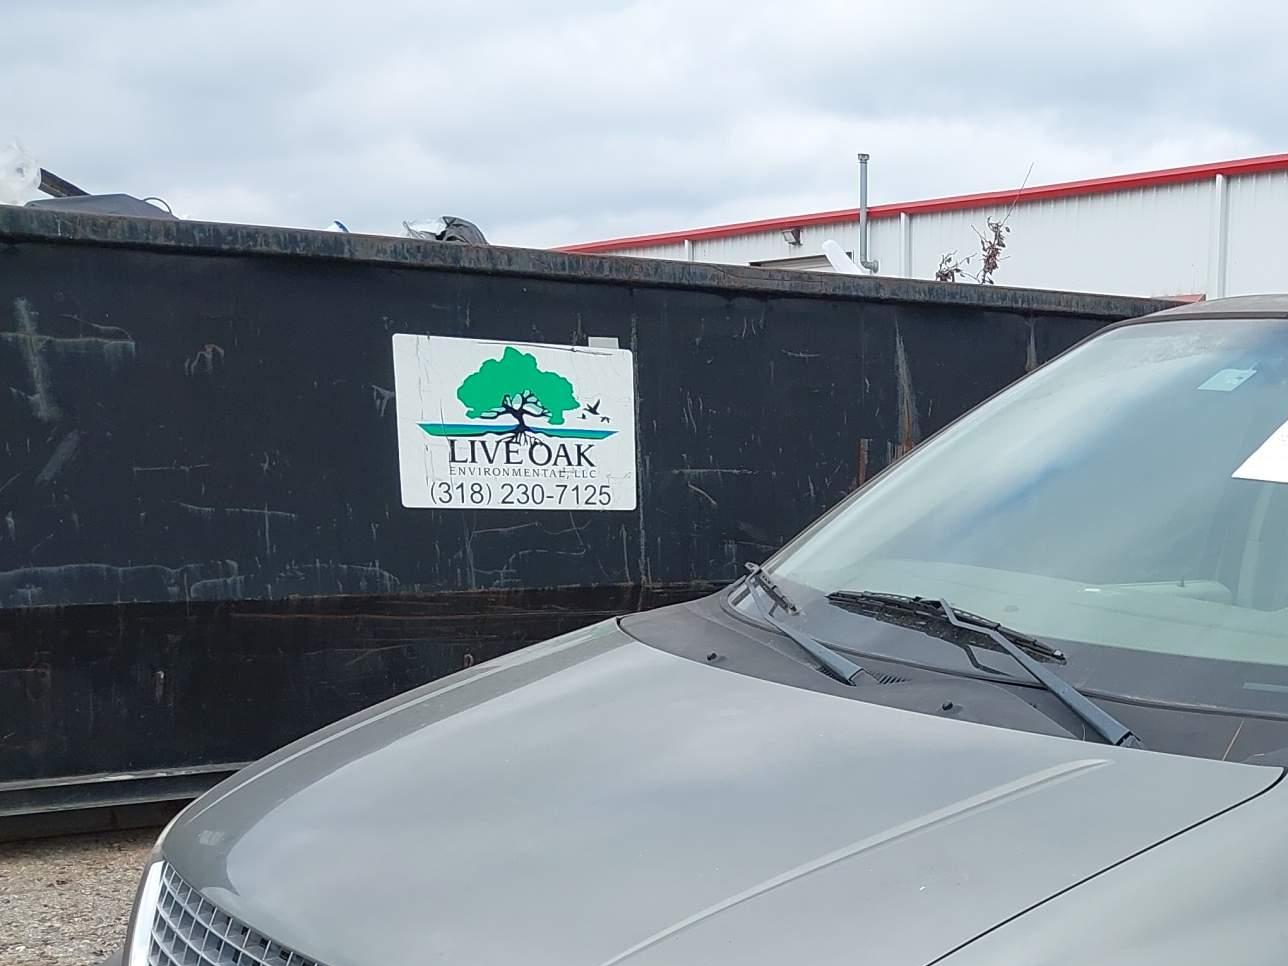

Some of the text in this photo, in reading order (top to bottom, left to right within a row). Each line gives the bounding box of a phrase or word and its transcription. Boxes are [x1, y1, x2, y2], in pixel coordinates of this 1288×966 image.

[449, 440, 597, 467] LIVE OAK
[574, 469, 597, 479] LLC
[430, 481, 612, 506] (318) 230-7125
